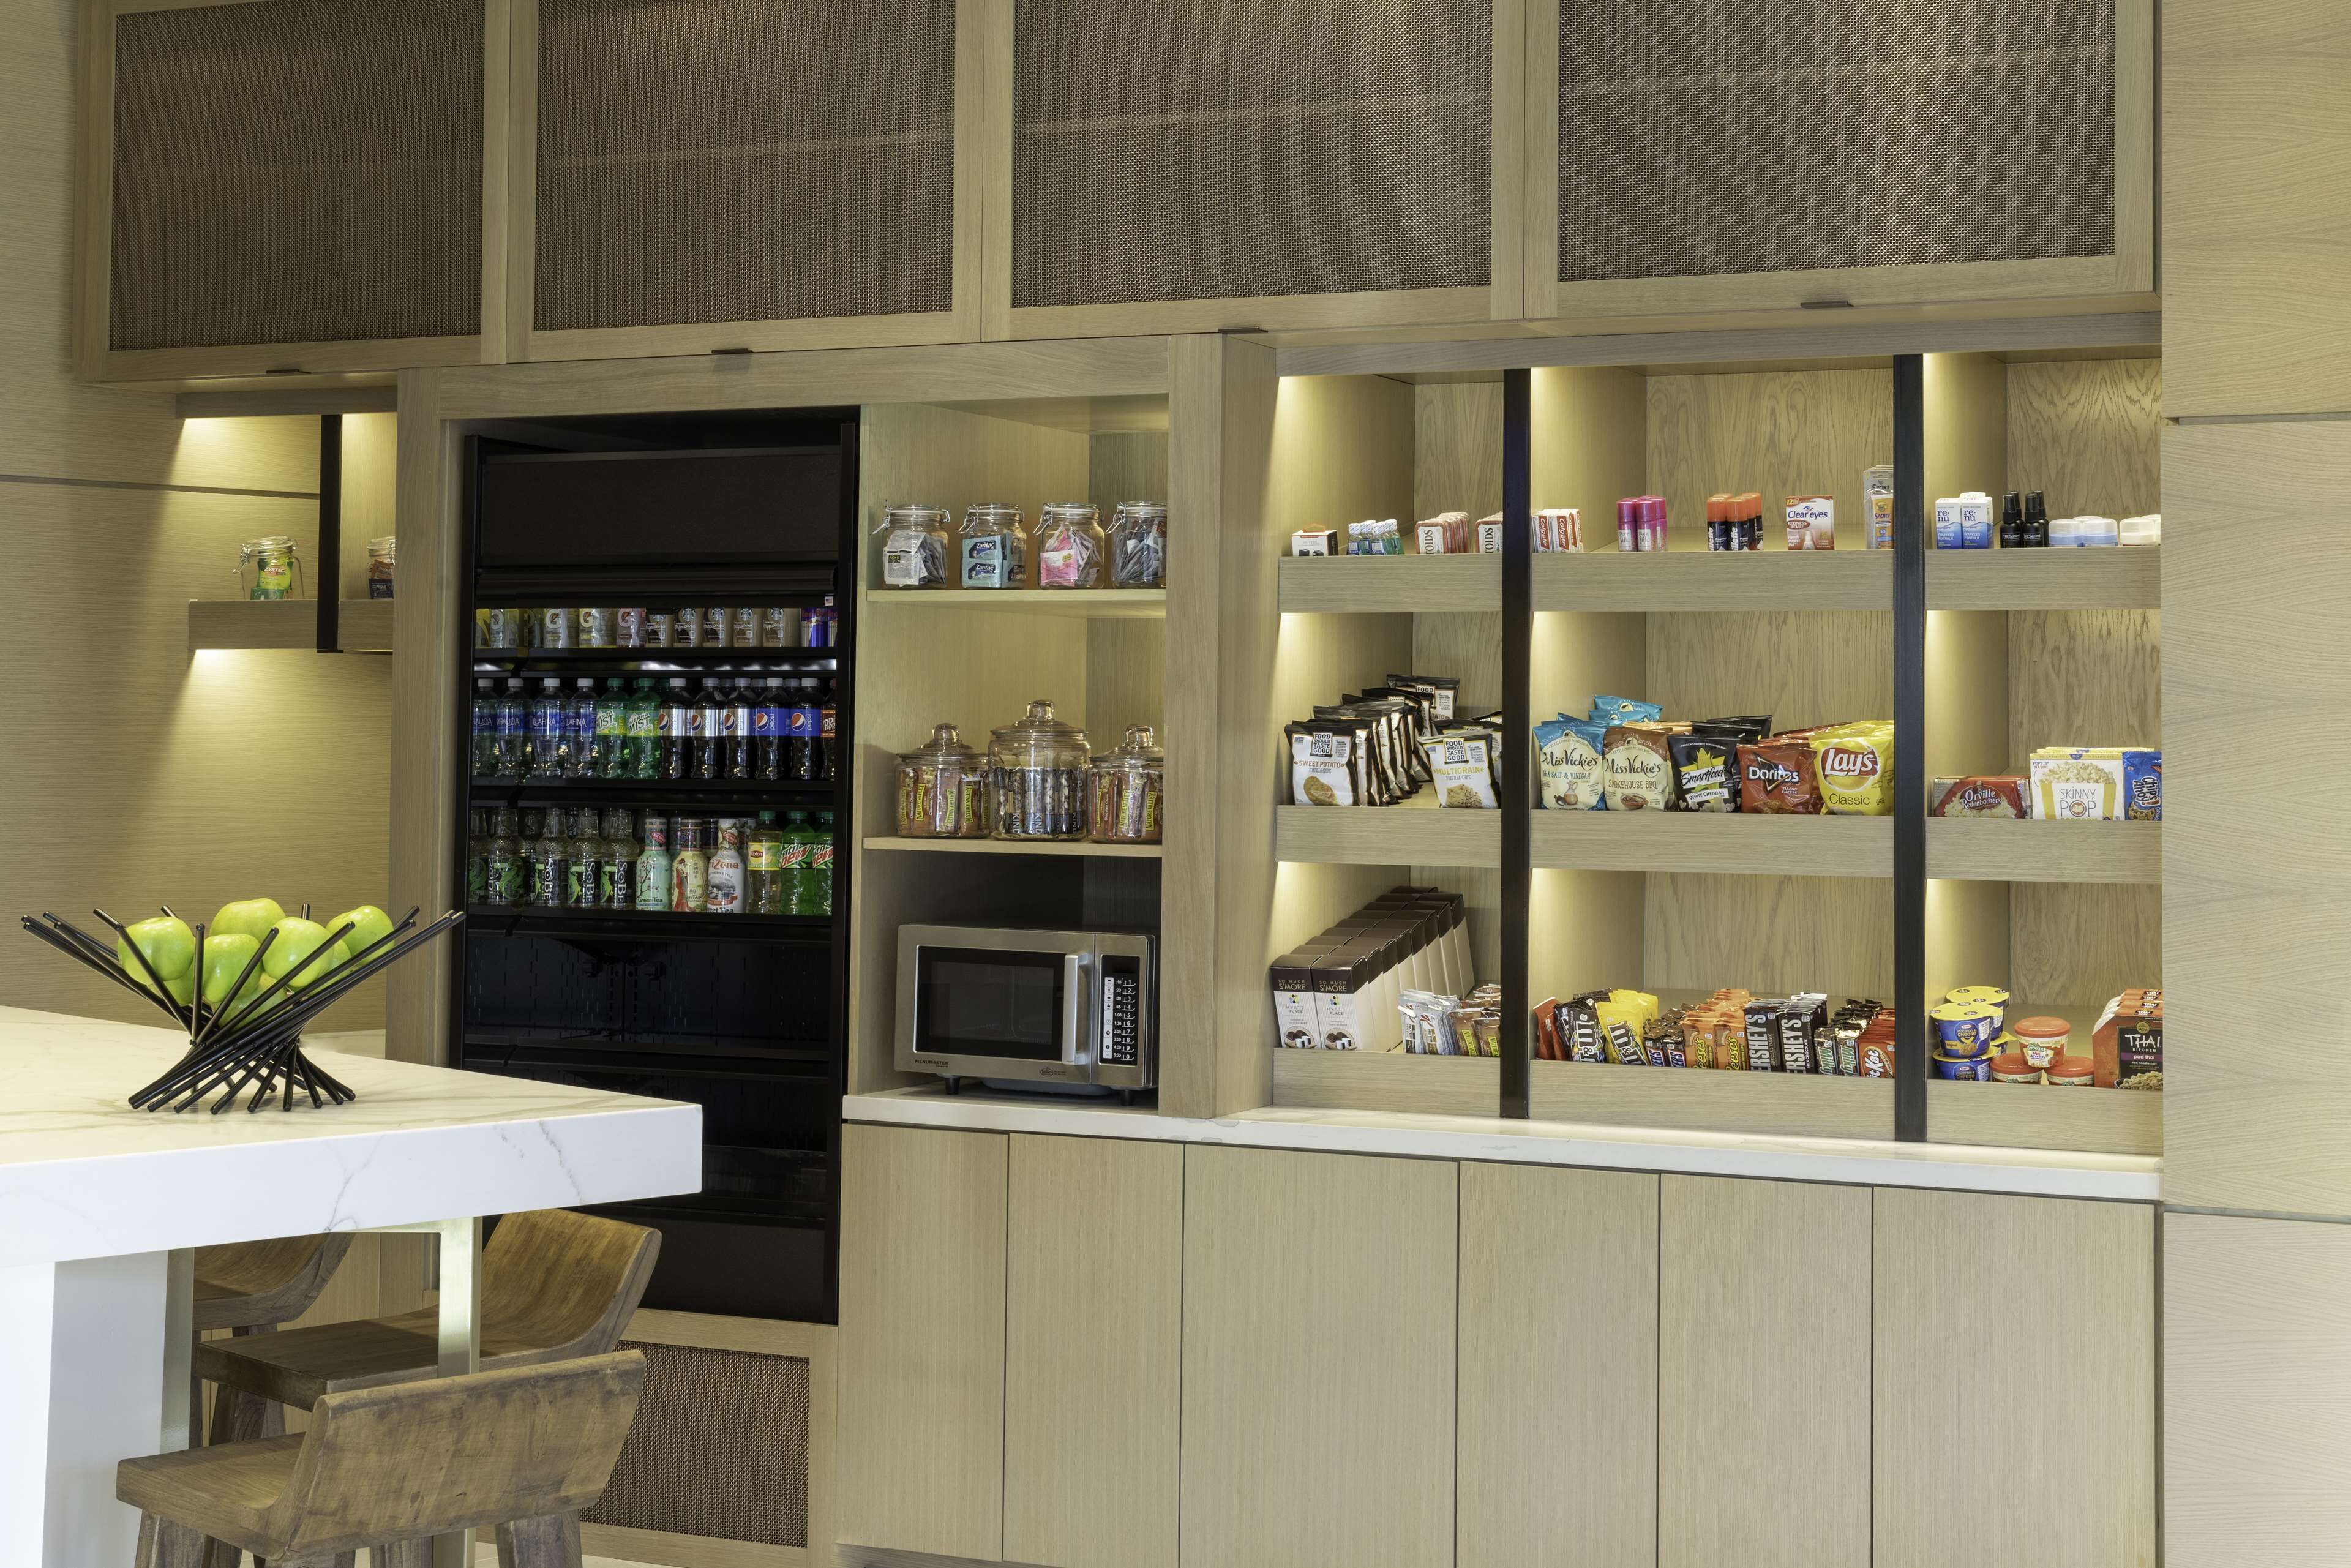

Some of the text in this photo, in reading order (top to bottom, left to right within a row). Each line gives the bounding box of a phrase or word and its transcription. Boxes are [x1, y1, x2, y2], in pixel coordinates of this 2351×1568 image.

[629, 717, 650, 733] MIST
[1542, 748, 1597, 771] Miss Vickie's
[1604, 755, 1661, 778] Miss Vickie's
[1824, 748, 1874, 776] Lay's
[1436, 766, 1480, 775] MULTIGRAIN
[1681, 765, 1725, 787] Smartfood
[1749, 767, 1799, 783] Doritos
[917, 784, 926, 801] VALLEY
[1645, 780, 1658, 789] BBQ
[2142, 776, 2159, 801] Chips
[1147, 792, 1156, 810] VALLEY
[1829, 793, 1870, 805] Classic
[1965, 789, 1996, 801] Orville
[2060, 786, 2096, 800] SKINNY
[946, 809, 954, 824] VALLEY
[2060, 800, 2096, 817] POP
[1463, 1030, 1474, 1047] NATURE
[1488, 1037, 1499, 1053] NATURE
[2124, 1034, 2161, 1048] THAI
[1865, 1050, 1884, 1072] Kat
